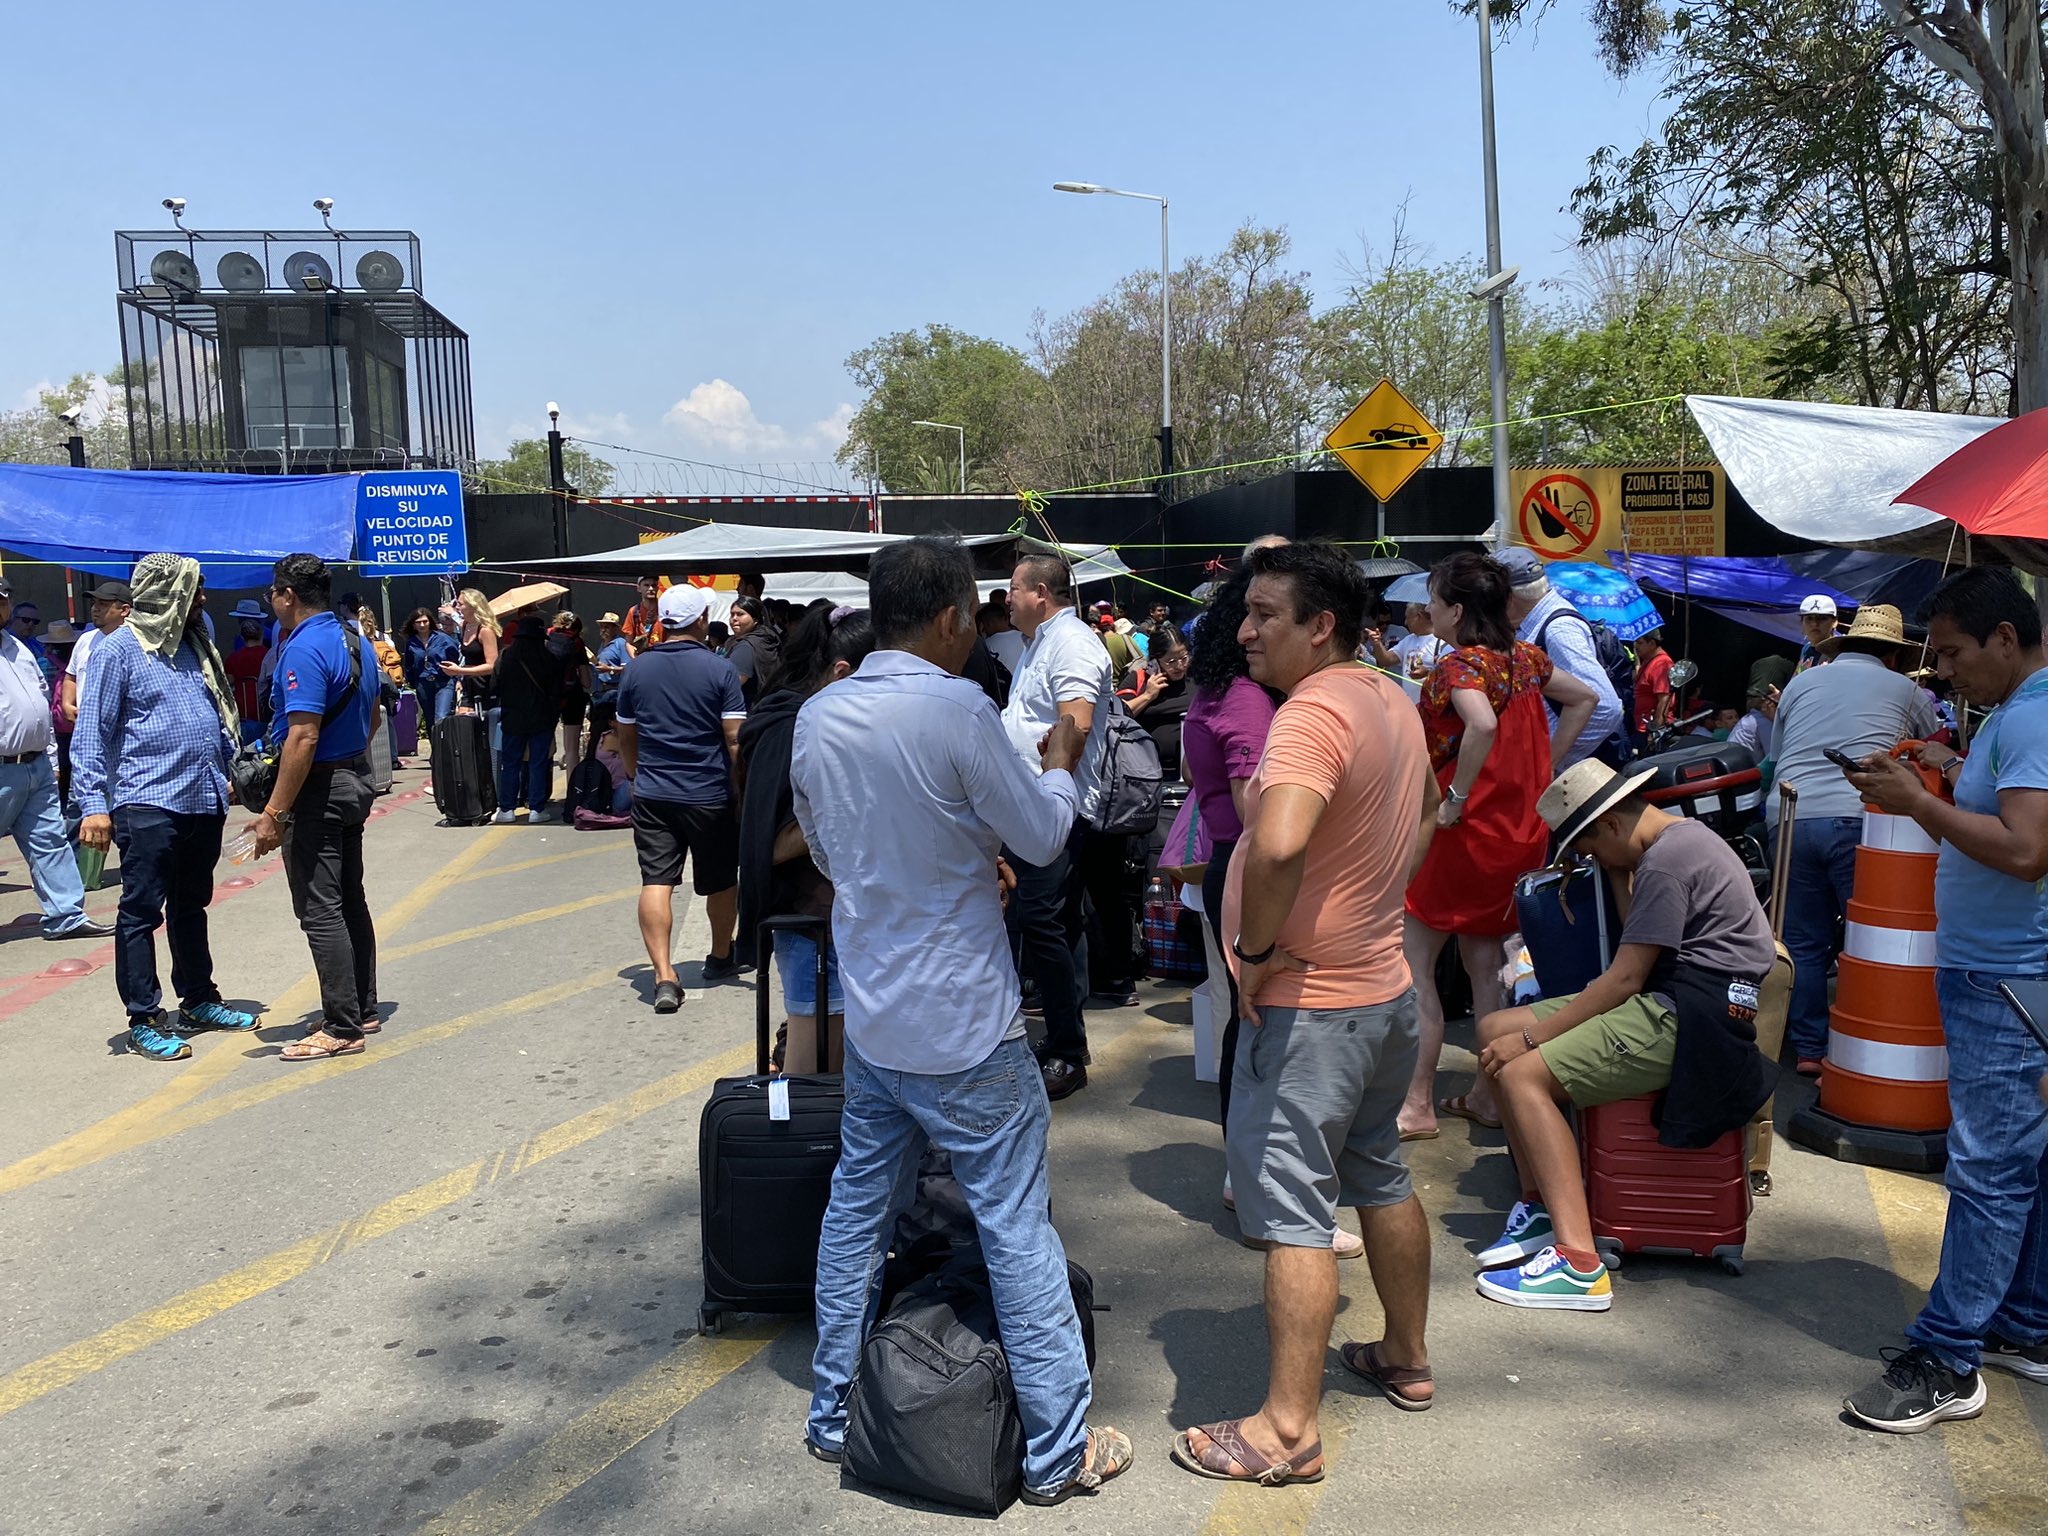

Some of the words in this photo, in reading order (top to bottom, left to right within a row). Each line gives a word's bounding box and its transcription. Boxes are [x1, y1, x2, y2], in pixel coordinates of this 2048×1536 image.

[1626, 475, 1657, 491] ZONA
[1660, 474, 1709, 490] FEDERAL
[366, 484, 448, 497] DISMINUYA
[398, 501, 418, 512] SU
[1625, 494, 1673, 507] PROHIBIDO
[1687, 493, 1710, 506] PASO
[366, 516, 453, 529] VELOCIDAD
[373, 533, 424, 547] PUNTO
[428, 533, 449, 545] DE
[1673, 536, 1691, 546] ZOA
[377, 547, 447, 563] REVISIÓN
